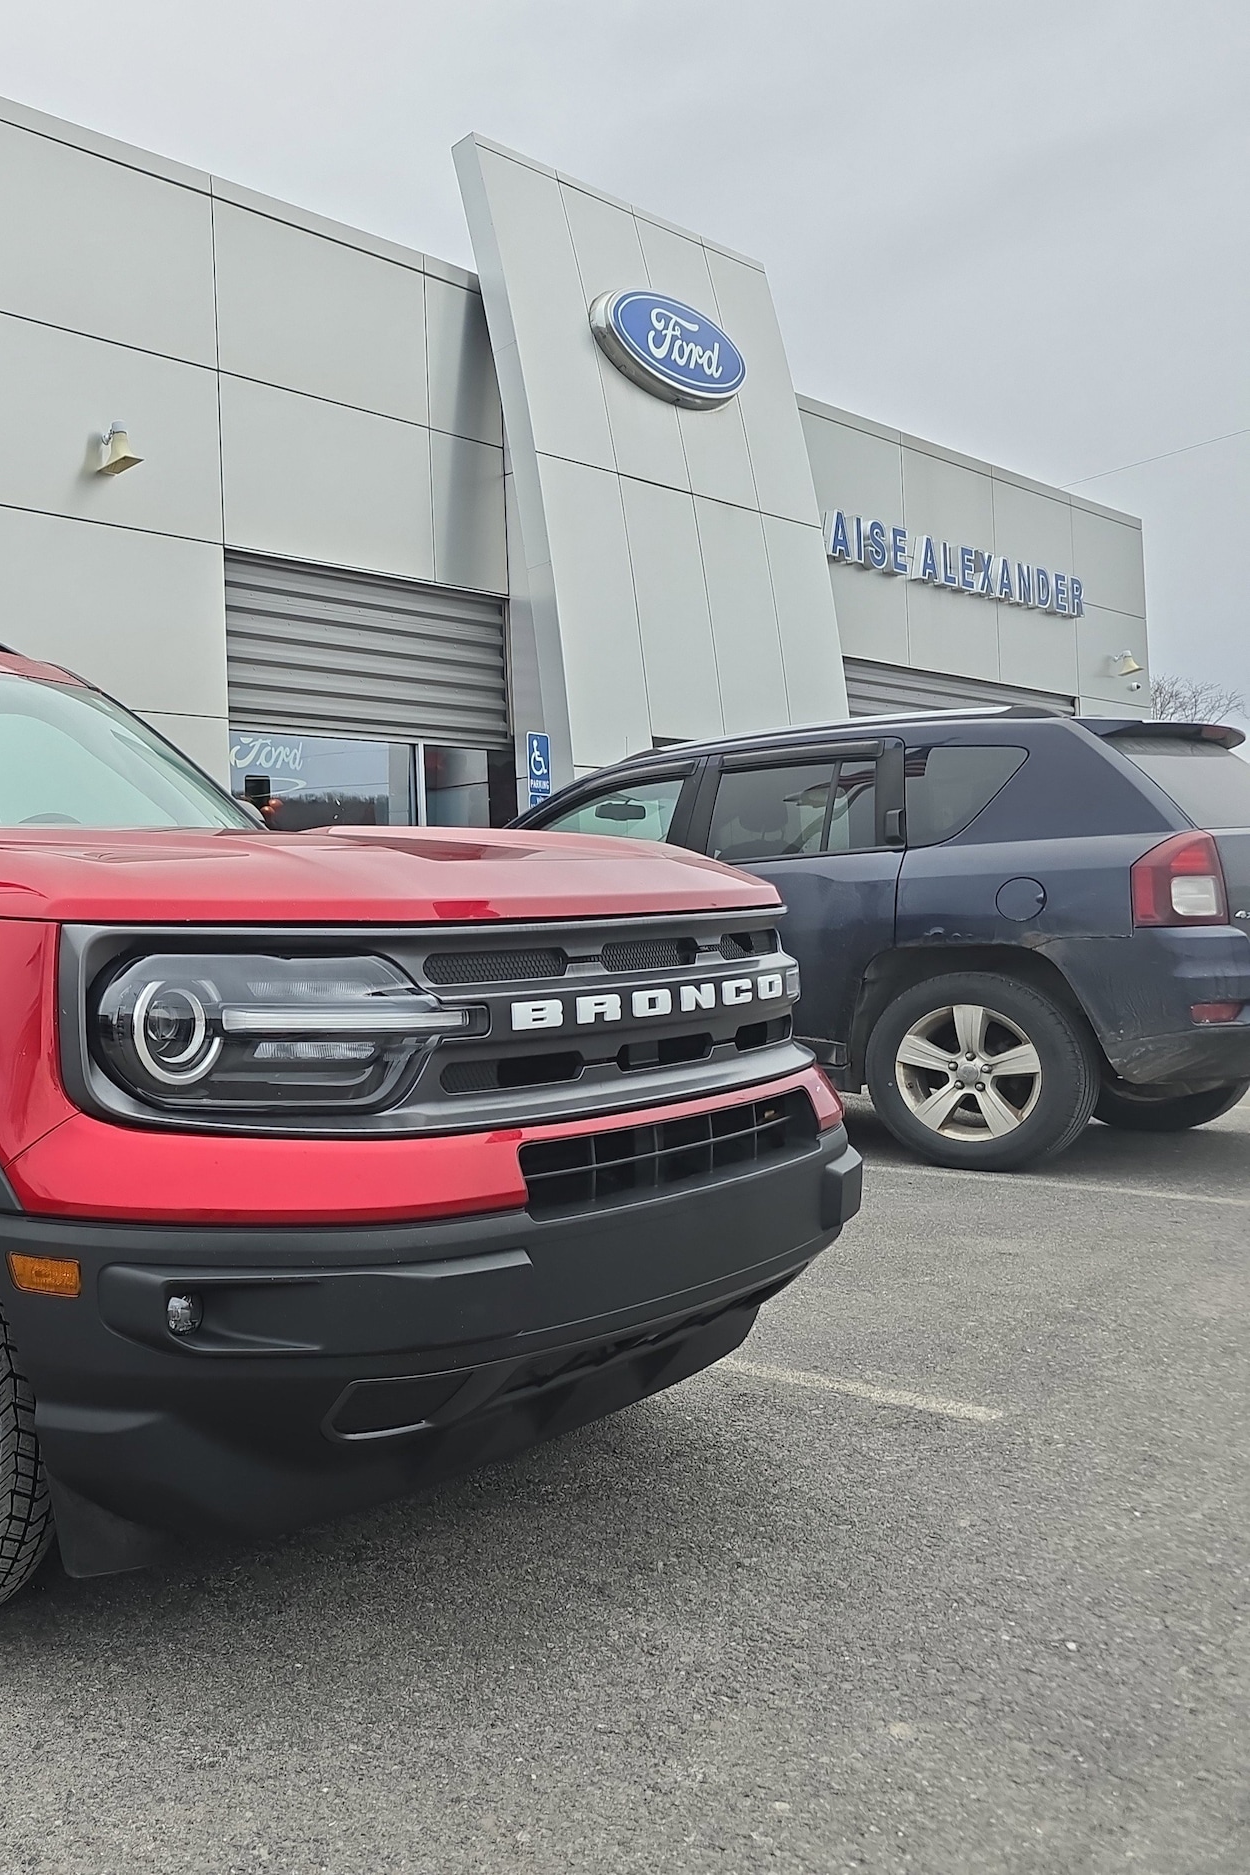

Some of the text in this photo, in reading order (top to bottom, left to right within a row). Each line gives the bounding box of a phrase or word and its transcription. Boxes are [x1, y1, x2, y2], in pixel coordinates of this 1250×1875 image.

[647, 307, 723, 379] Ford
[913, 534, 1085, 619] ALEXANDER
[230, 736, 304, 771] Ford
[530, 778, 550, 790] PARKING
[510, 973, 784, 1031] BRONCO
